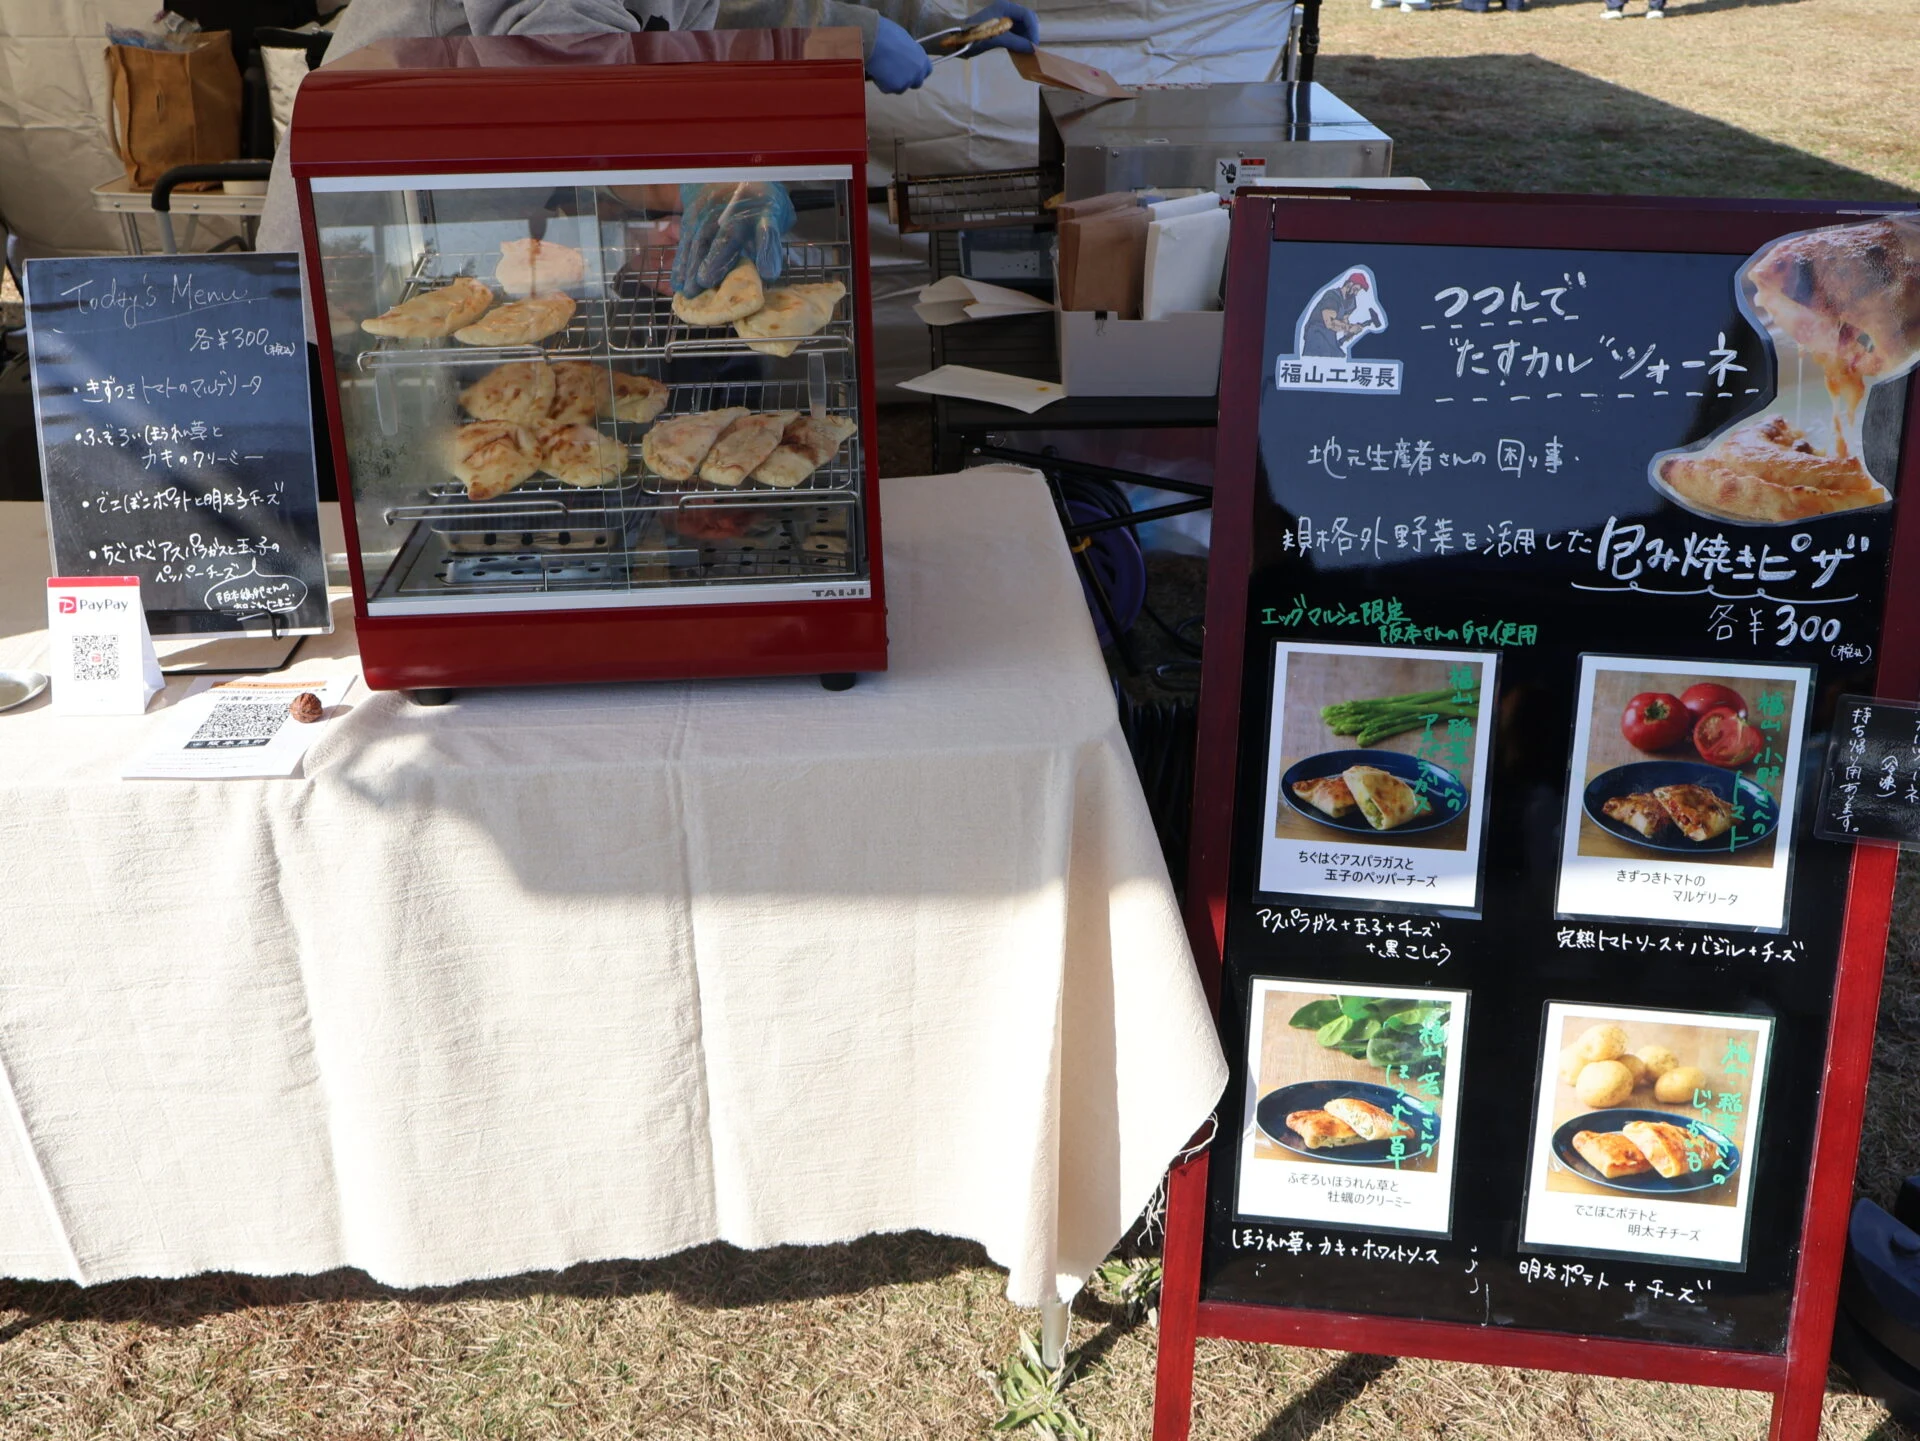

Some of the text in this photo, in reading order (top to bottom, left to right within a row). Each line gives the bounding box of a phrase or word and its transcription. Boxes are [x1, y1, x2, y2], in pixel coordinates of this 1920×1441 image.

[61, 273, 157, 329] Today's
[1434, 271, 1587, 318] つつんで
[1280, 362, 1396, 388] 福山工場長
[155, 563, 239, 583] ペッパーチーズ
[812, 588, 865, 598] TAIJI
[79, 598, 129, 612] PayPay
[1261, 594, 1411, 627] エッグマルシェ限定
[1379, 619, 1538, 646] 阪本さんの卵使用
[1730, 770, 1750, 853] トマト
[1298, 850, 1414, 871] ちぐはぐアスパラガスと
[1324, 869, 1438, 888] 玉子のペッパーチーズ
[1616, 869, 1706, 888] きずつきトマトの
[1672, 889, 1738, 907] マルゲリータ
[1287, 1172, 1399, 1192] ふぞろいほうれん草と
[1327, 1190, 1411, 1208] 牡蠣のクリーミー
[1574, 1203, 1657, 1223] でこぼこポテトと
[1627, 1223, 1701, 1241] 明太子チーズ
